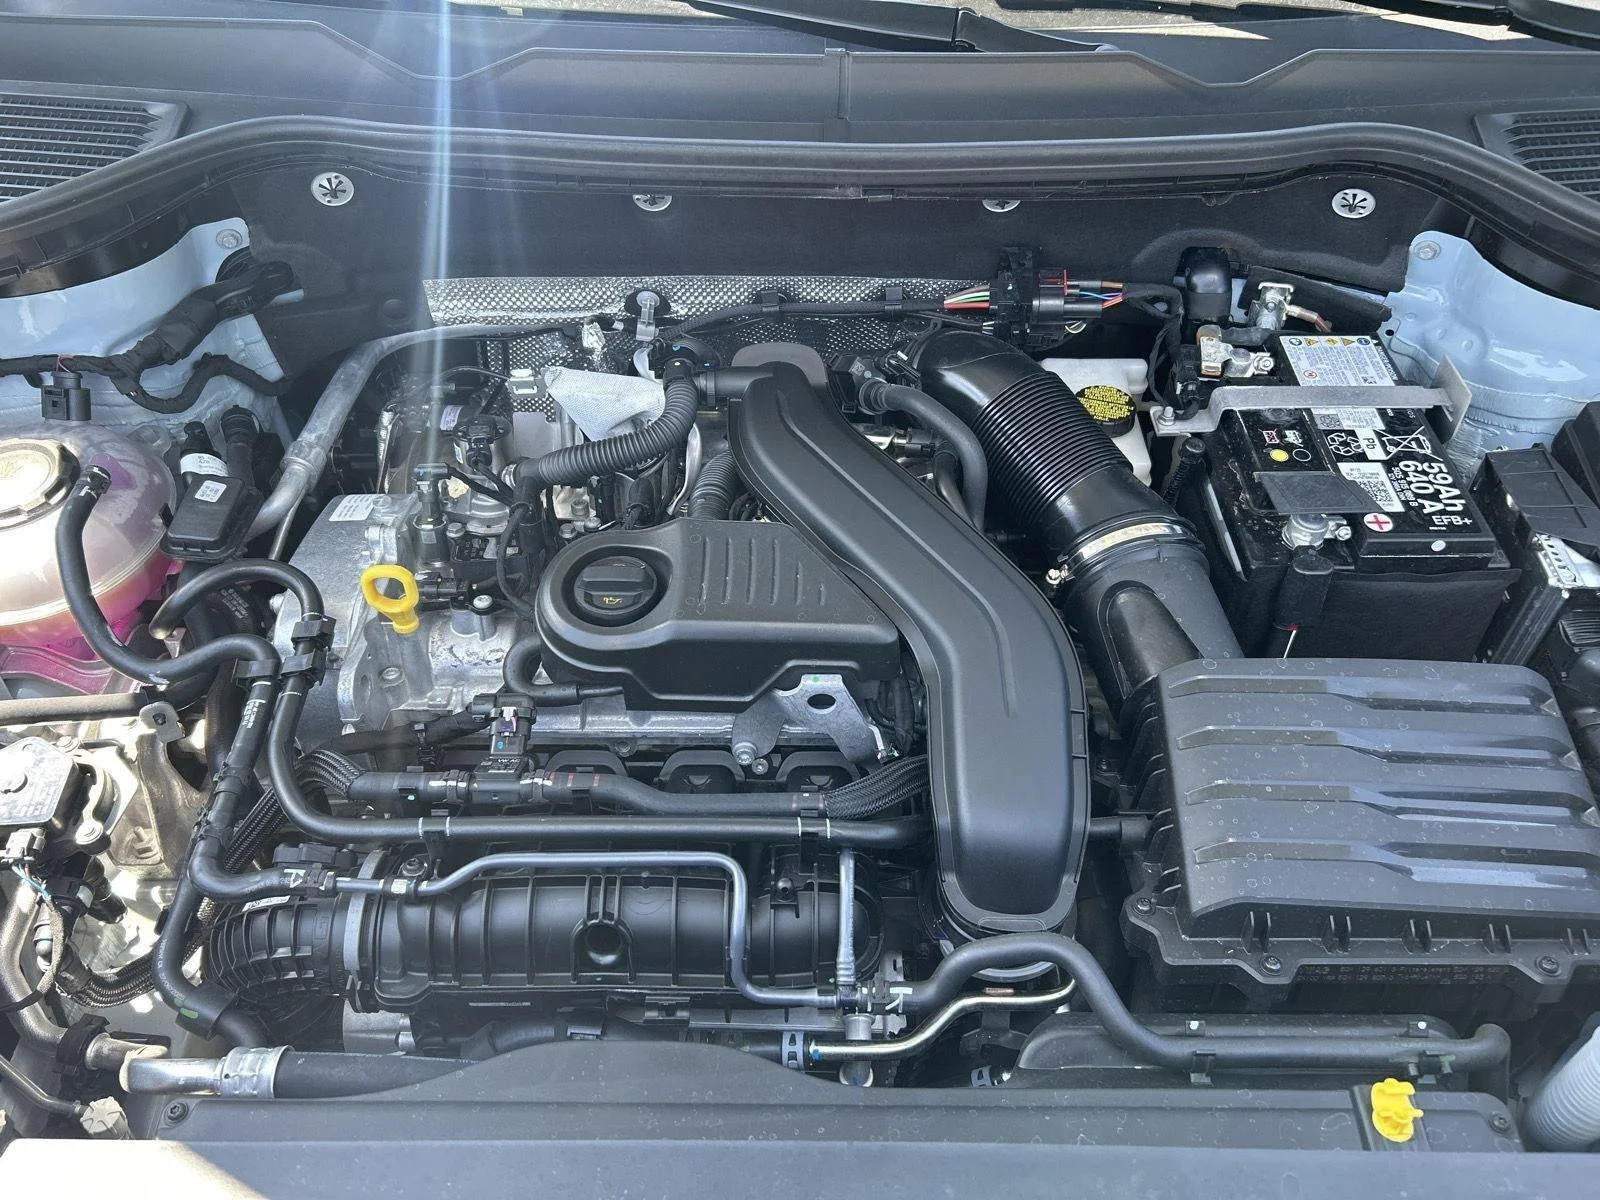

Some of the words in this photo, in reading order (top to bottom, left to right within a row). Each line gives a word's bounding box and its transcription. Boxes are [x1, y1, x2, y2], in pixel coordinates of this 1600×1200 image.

[1363, 437, 1377, 450] Pb
[1398, 460, 1435, 495] 640
[1422, 462, 1466, 512] 59Ah
[1416, 498, 1445, 514] A
[1431, 515, 1473, 525] EFB+
